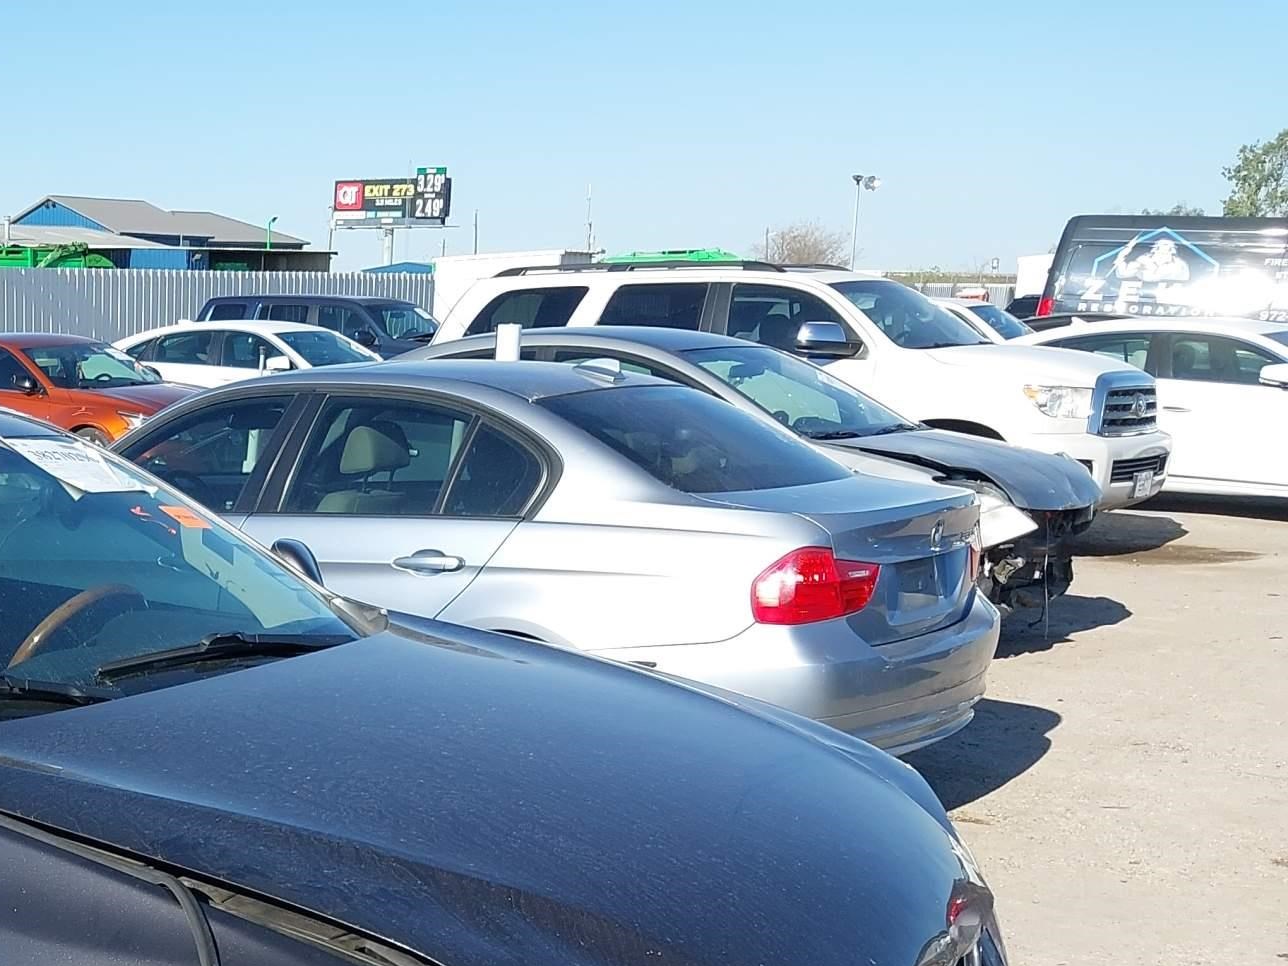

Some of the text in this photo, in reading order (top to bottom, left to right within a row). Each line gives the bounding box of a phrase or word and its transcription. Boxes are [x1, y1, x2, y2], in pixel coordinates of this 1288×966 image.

[338, 186, 358, 205] QT
[364, 185, 391, 197] EXIT
[392, 184, 415, 196] 273
